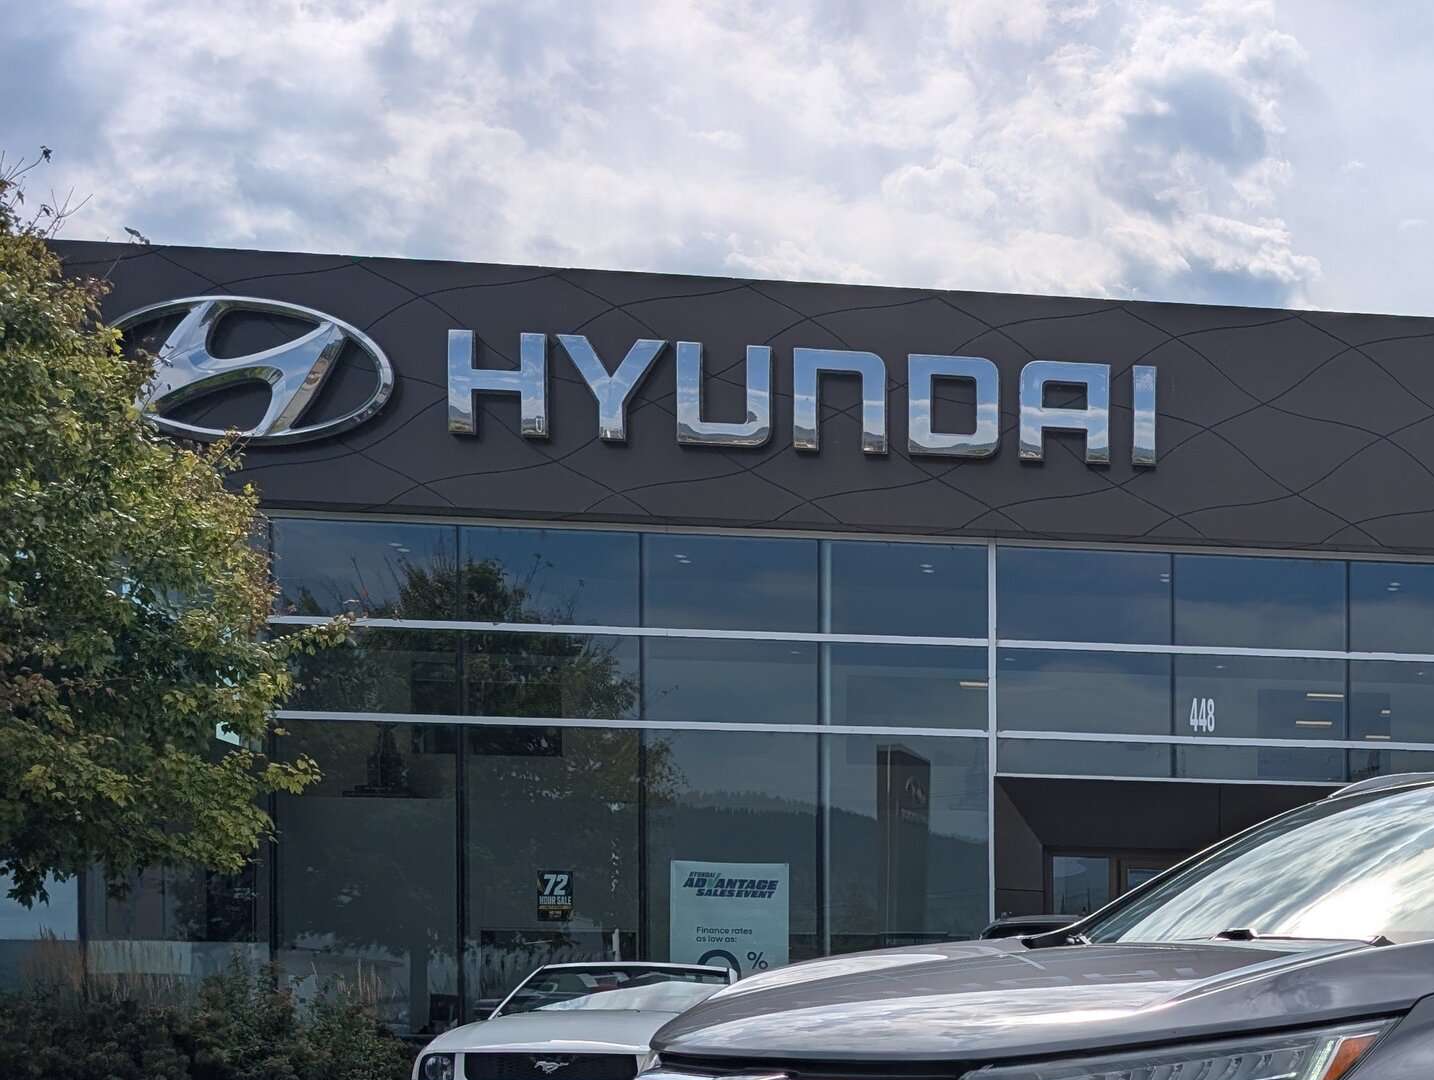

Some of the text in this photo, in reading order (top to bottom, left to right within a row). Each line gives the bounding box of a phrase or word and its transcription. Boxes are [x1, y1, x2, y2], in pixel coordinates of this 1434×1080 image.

[447, 328, 1157, 467] HYUNDAI
[1189, 697, 1215, 732] 448
[543, 873, 569, 896] 72
[682, 876, 779, 891] ADVANTAGE
[539, 895, 572, 905] HOUR SALE
[696, 926, 753, 935] Finance rates
[695, 935, 707, 943] as
[707, 935, 724, 943] low
